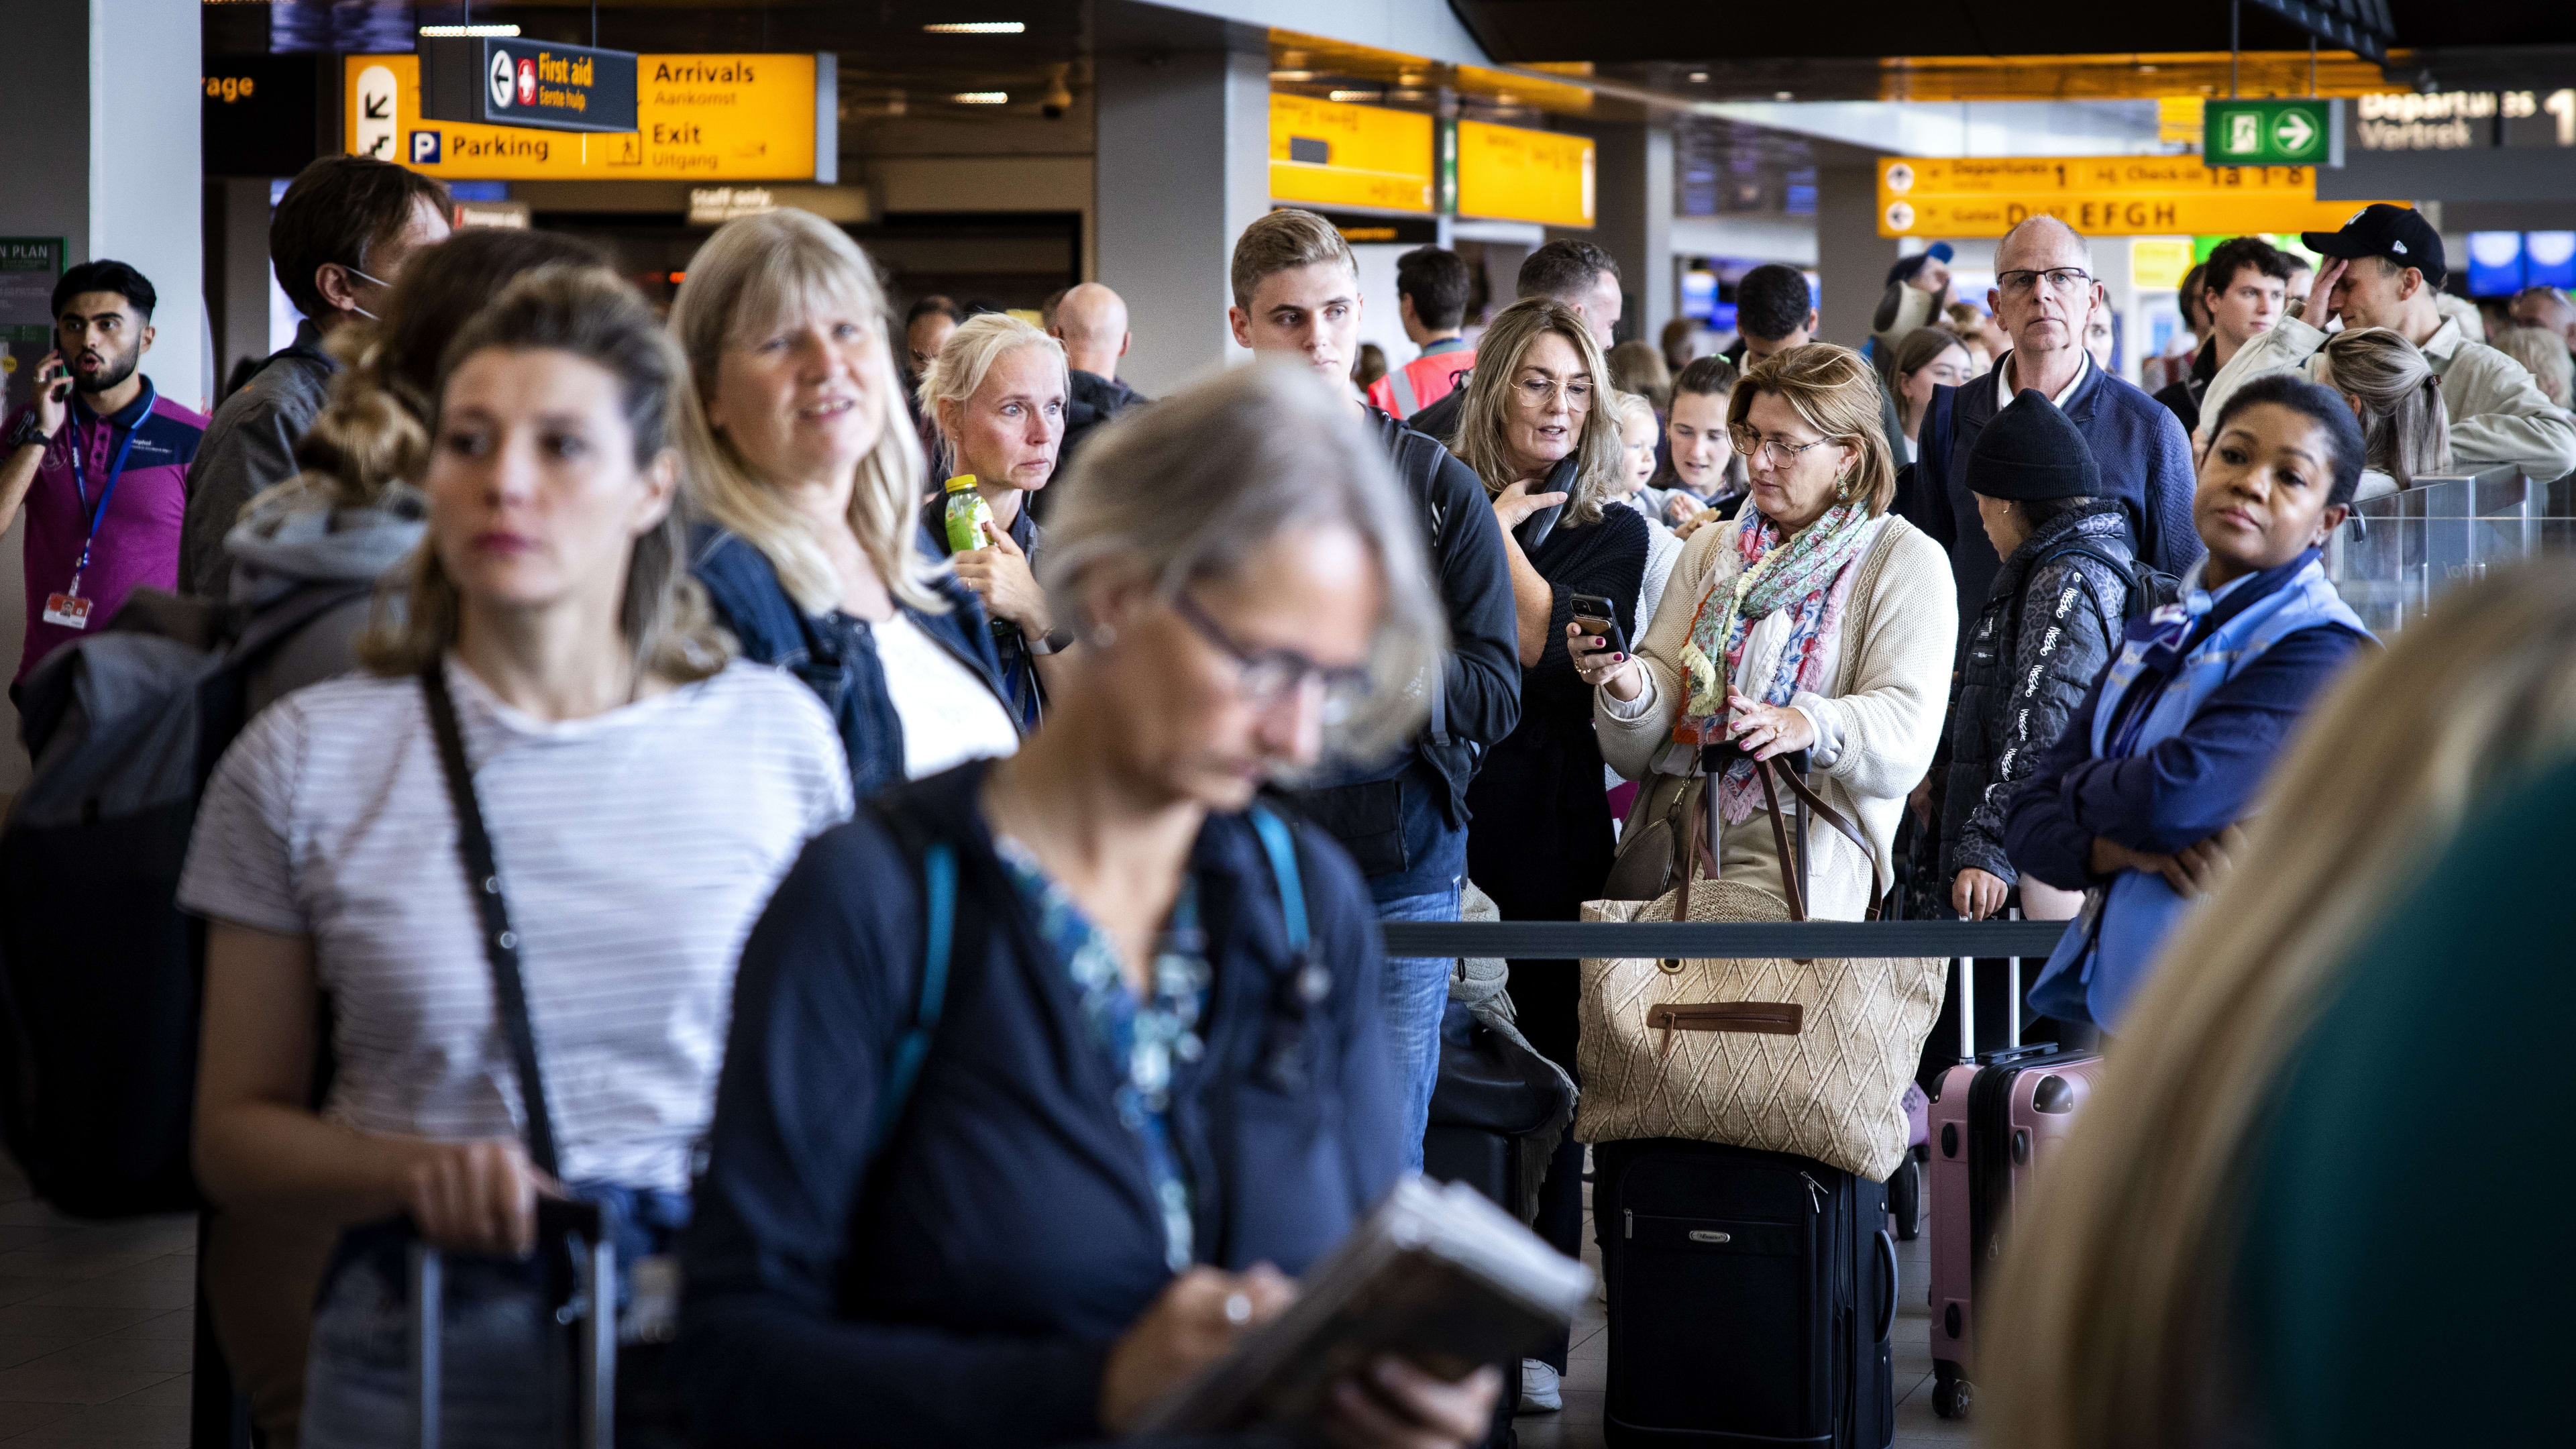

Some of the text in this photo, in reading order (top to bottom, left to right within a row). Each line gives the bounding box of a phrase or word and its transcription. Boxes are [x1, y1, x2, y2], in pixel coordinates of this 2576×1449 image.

[539, 52, 593, 87] First aid
[653, 60, 755, 82] Arrivals
[201, 76, 254, 102] age
[539, 86, 565, 107] Eerste
[653, 91, 737, 105] Aankomst
[2543, 88, 2576, 147] 1
[653, 121, 700, 144] Exit
[2357, 119, 2473, 151] Vertrek
[415, 132, 549, 162] P Parking
[653, 150, 718, 169] Uitgang
[13, 245, 47, 258] PLAN
